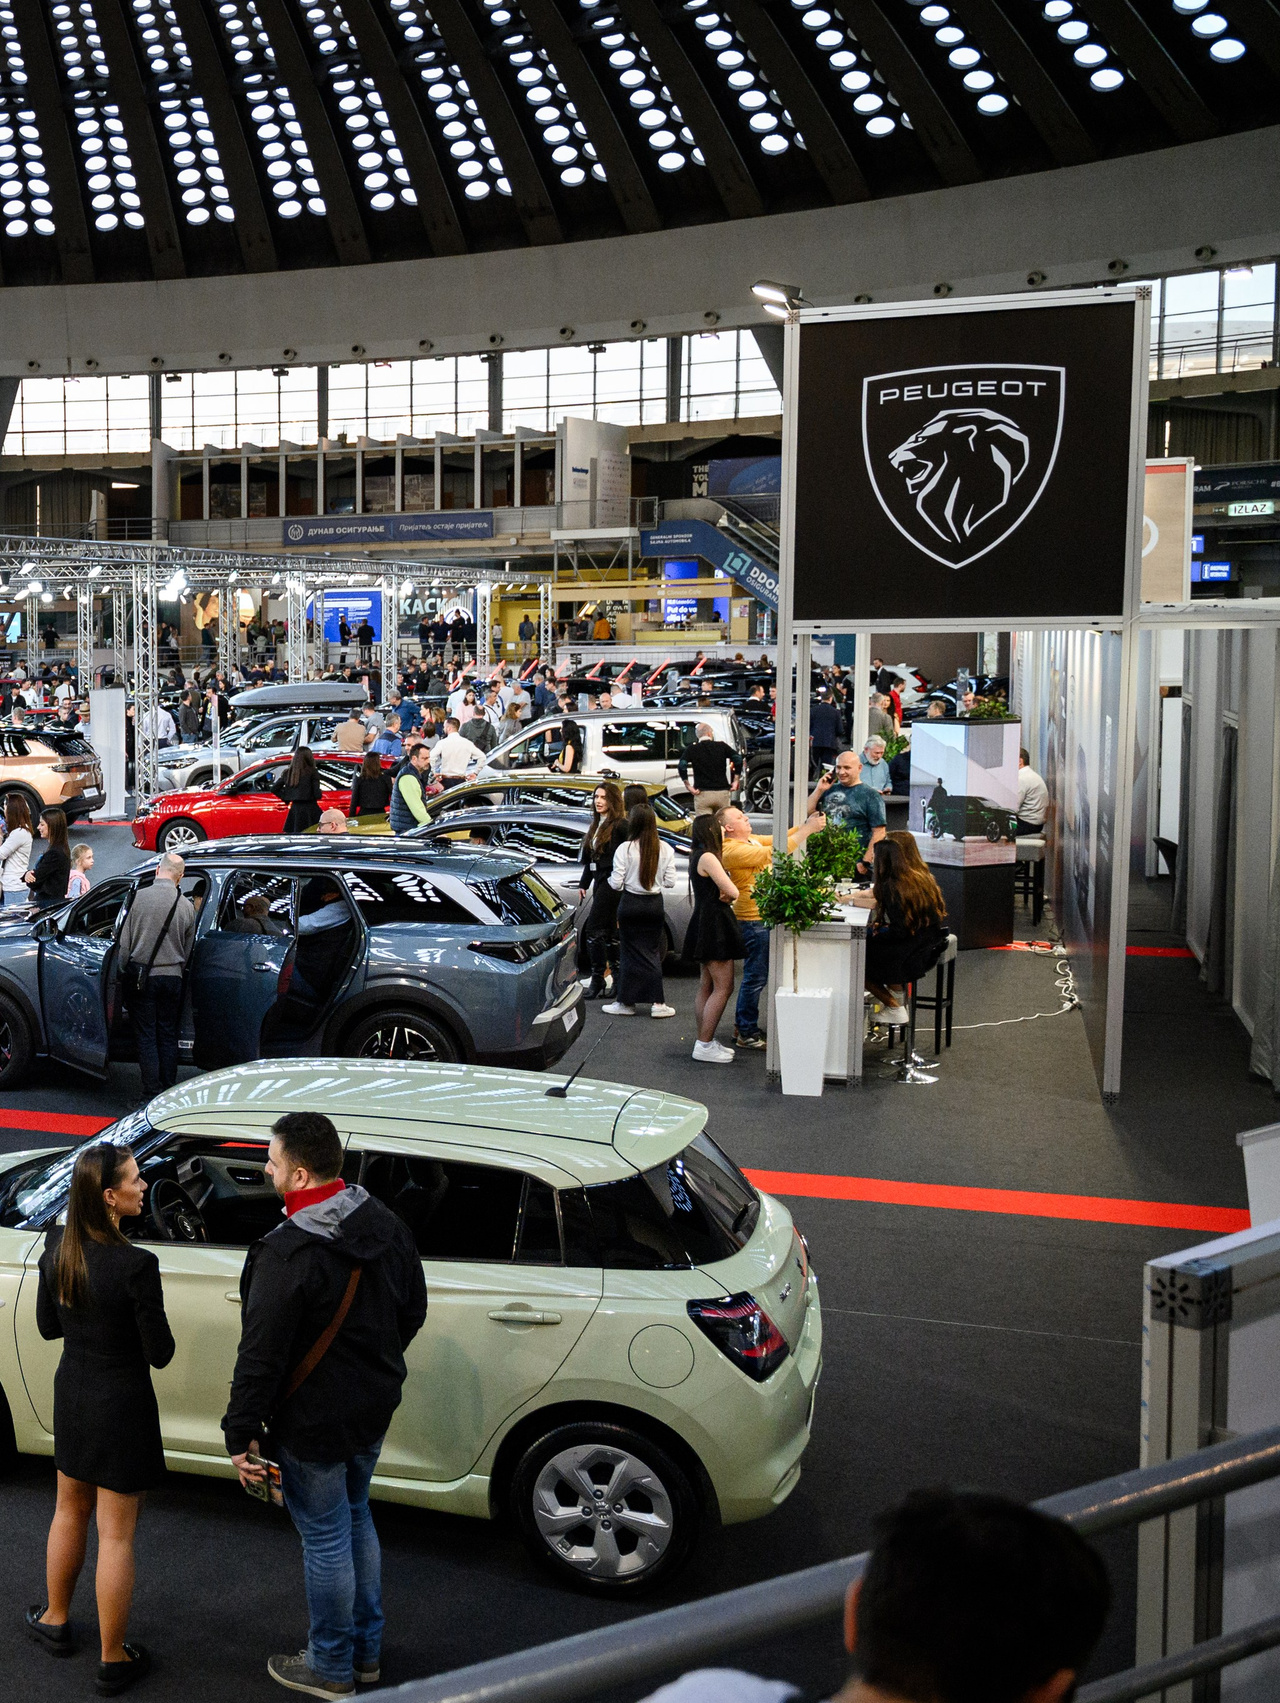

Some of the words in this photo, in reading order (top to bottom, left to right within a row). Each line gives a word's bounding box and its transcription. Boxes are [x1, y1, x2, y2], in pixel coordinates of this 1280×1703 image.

[880, 380, 1047, 405] PEUGEOT
[1234, 504, 1267, 514] IZLAZ
[308, 527, 334, 537] ДУНАВ
[336, 525, 385, 535] ОСИГУРАЊЕ
[399, 523, 432, 532] Пријатељ
[433, 522, 454, 531] остаје
[456, 521, 489, 531] пријатељ
